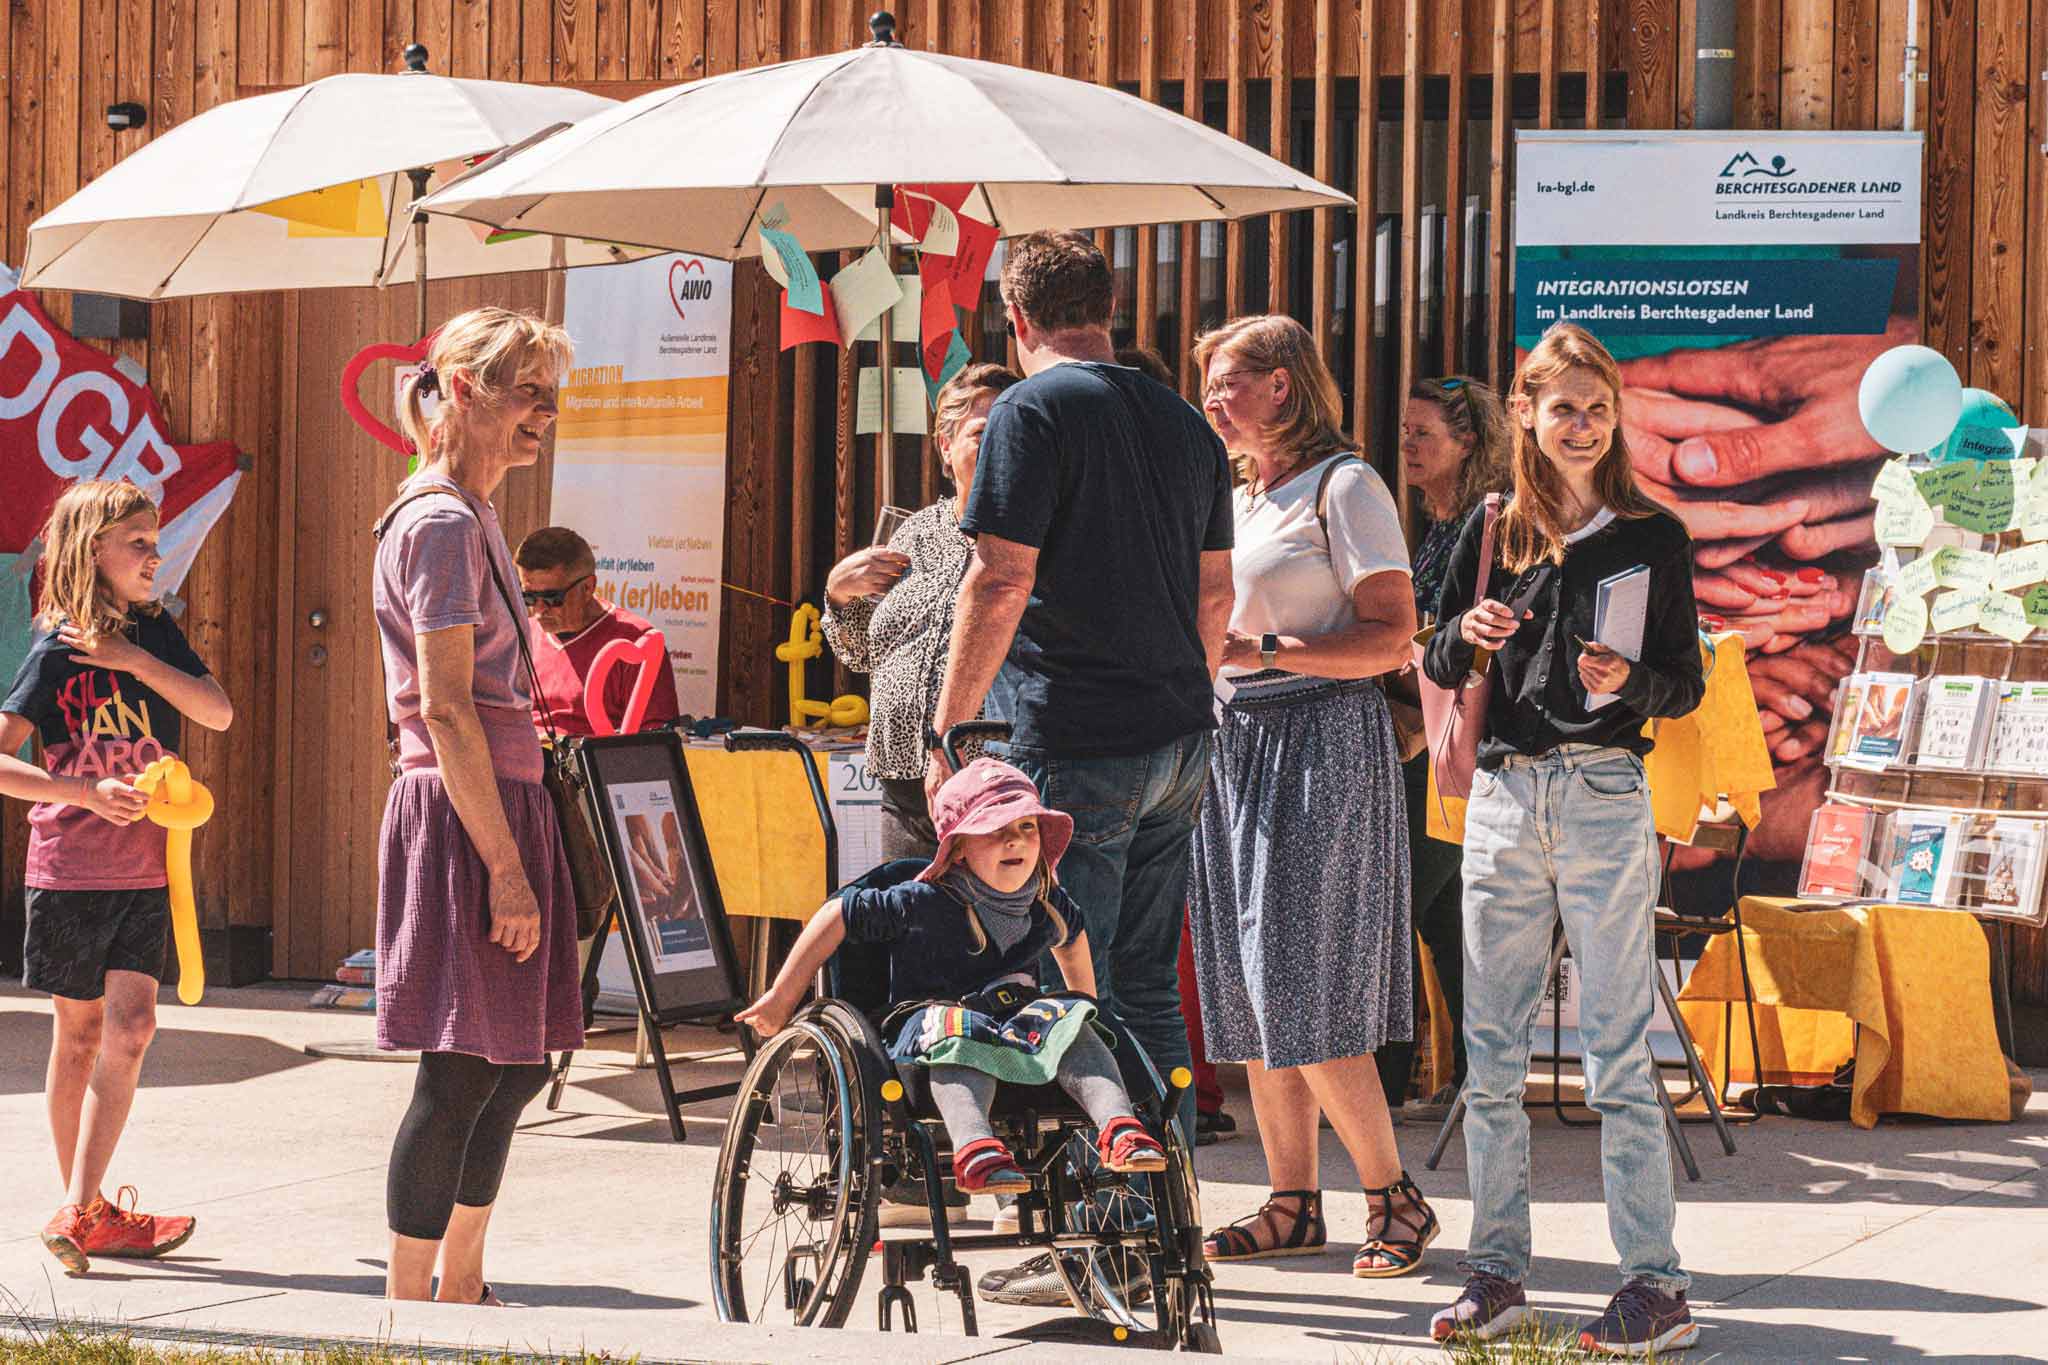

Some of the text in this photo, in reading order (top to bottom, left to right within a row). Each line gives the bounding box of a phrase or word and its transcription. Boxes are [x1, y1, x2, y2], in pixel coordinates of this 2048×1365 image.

[1537, 181, 1595, 195] lra-bgl.de
[1715, 182, 1902, 195] BERCHTESGADENER LAND
[1715, 208, 1885, 221] Landkreis Berchtesgadener Land
[680, 279, 712, 300] AWO
[1536, 280, 1749, 296] INTEGRATIONSLOTSEN
[1536, 304, 1814, 324] im Landkreis Berchtesgadener Land
[568, 365, 624, 385] MIGRATION
[616, 557, 655, 575] (er)leben
[620, 580, 710, 616] (er)leben
[56, 736, 164, 778] ARO
[843, 763, 883, 791] 20
